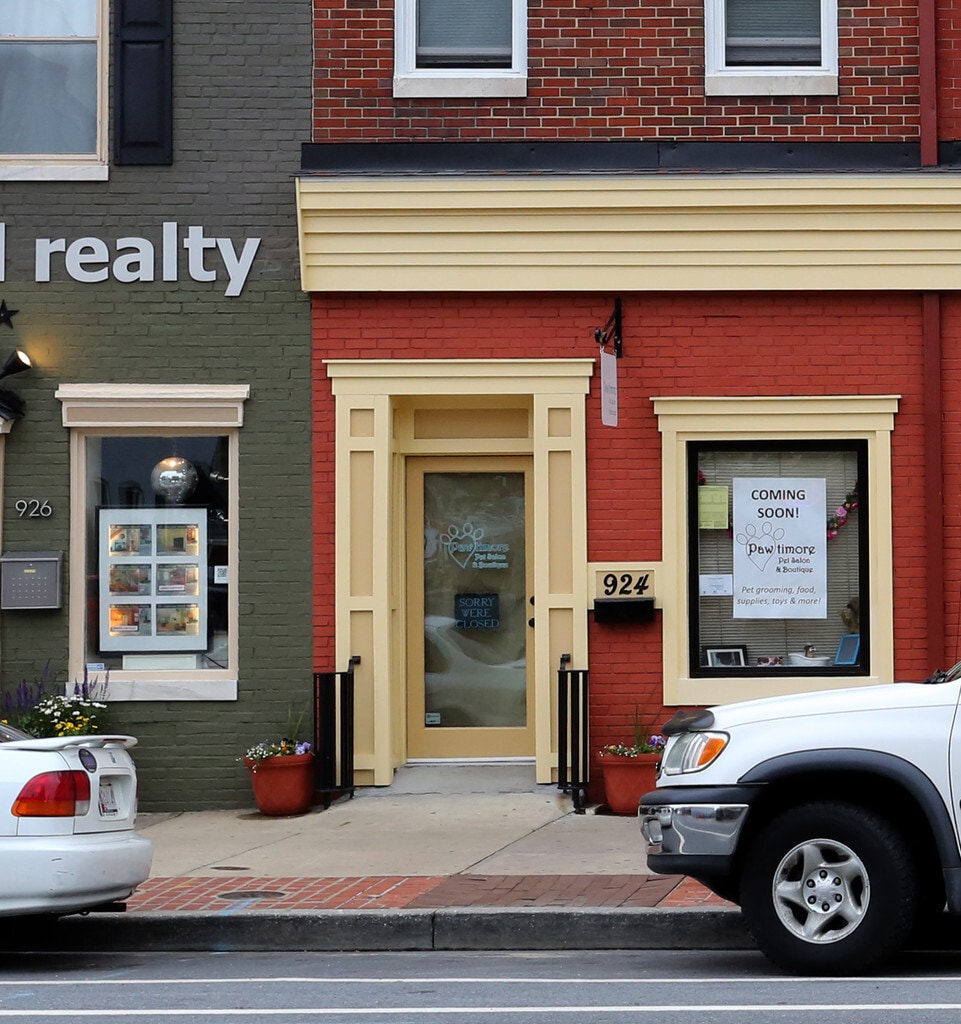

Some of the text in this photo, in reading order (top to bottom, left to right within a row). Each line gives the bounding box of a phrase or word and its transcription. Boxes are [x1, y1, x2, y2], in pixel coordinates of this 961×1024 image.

[35, 221, 261, 297] realty
[751, 489, 806, 501] COMING
[15, 499, 52, 517] 926
[757, 507, 799, 519] SOON!
[782, 566, 813, 574] Boutique
[603, 573, 649, 595] 924
[756, 586, 794, 595] grooming,
[796, 586, 816, 595] food,
[459, 598, 494, 606] SORRY
[456, 619, 500, 628] CLOSED
